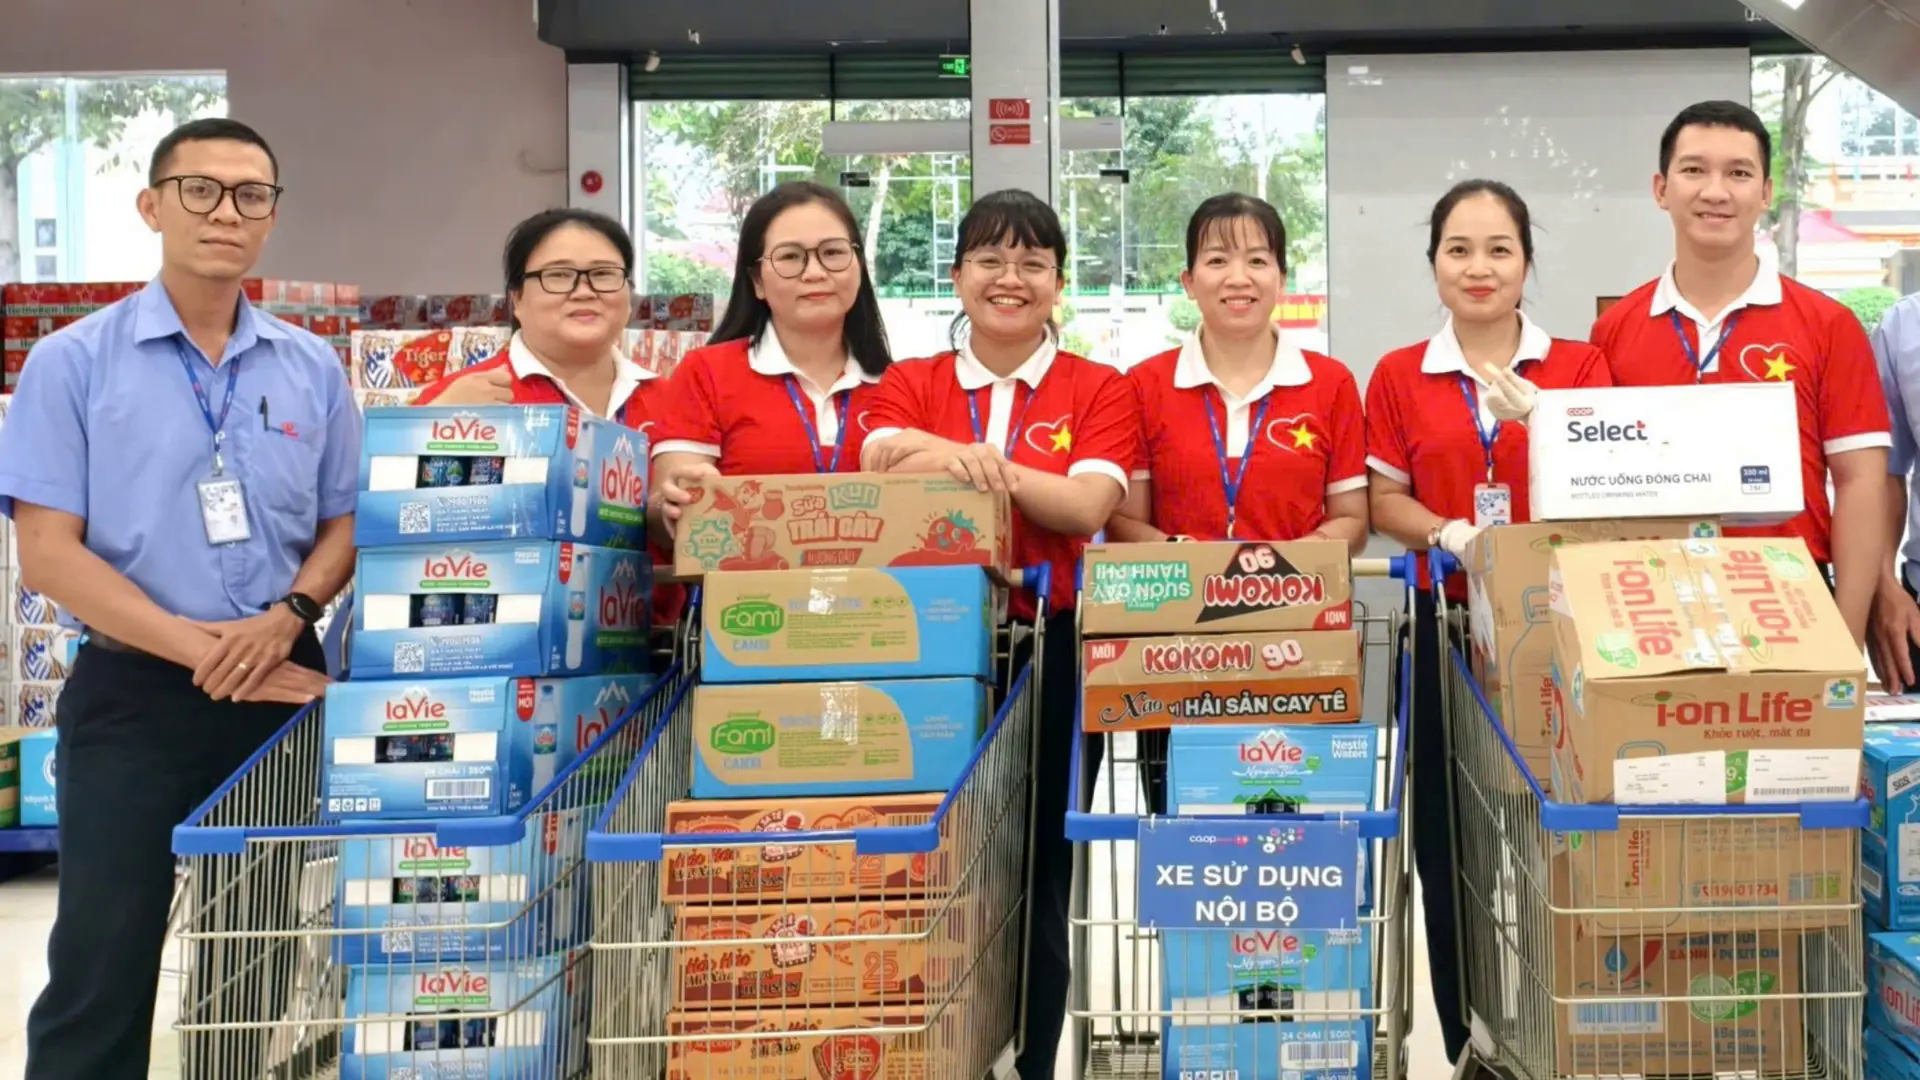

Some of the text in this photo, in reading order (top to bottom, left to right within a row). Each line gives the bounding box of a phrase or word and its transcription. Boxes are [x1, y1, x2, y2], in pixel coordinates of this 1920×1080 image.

[404, 346, 446, 371] Tiger
[432, 418, 497, 441] laVie
[1567, 420, 1648, 443] Select
[601, 455, 643, 506] laVie
[1570, 472, 1712, 486] NƯỚC UỐNG ĐÓNG CHAI
[791, 495, 826, 516] Sữa
[788, 511, 884, 544] TRÁI CÂY
[424, 555, 488, 579] laVie
[1133, 562, 1188, 580] HÀNH
[1239, 547, 1276, 573] 90
[1722, 550, 1775, 594] Life
[1204, 574, 1325, 607] KOKOMI
[724, 607, 780, 628] Fami
[1325, 611, 1347, 625] MỚI
[1628, 608, 1682, 657] Life
[1091, 639, 1304, 674] MỚI KOKOMI 90
[386, 696, 446, 721] laVie
[1100, 692, 1165, 725] Xào
[1185, 691, 1222, 718] HẢI
[1225, 690, 1269, 715] SẢN
[1272, 692, 1316, 714] CAY
[1317, 689, 1347, 712] TÊ
[1738, 691, 1814, 725] Life
[714, 723, 773, 745] Fami
[1703, 727, 1733, 739] Khỏe
[1796, 726, 1811, 737] da
[1240, 740, 1304, 763] laVie
[1332, 739, 1369, 751] Nestlé
[1332, 750, 1368, 759] Waters
[1156, 860, 1343, 891] XE SỬ DỤNG
[1195, 895, 1299, 926] NỘI BỘ
[1233, 930, 1298, 954] laVe
[686, 948, 752, 973] Hảo Hảo
[863, 950, 899, 981] 25
[420, 970, 488, 994] laVie
[1296, 1031, 1321, 1041] CHAI
